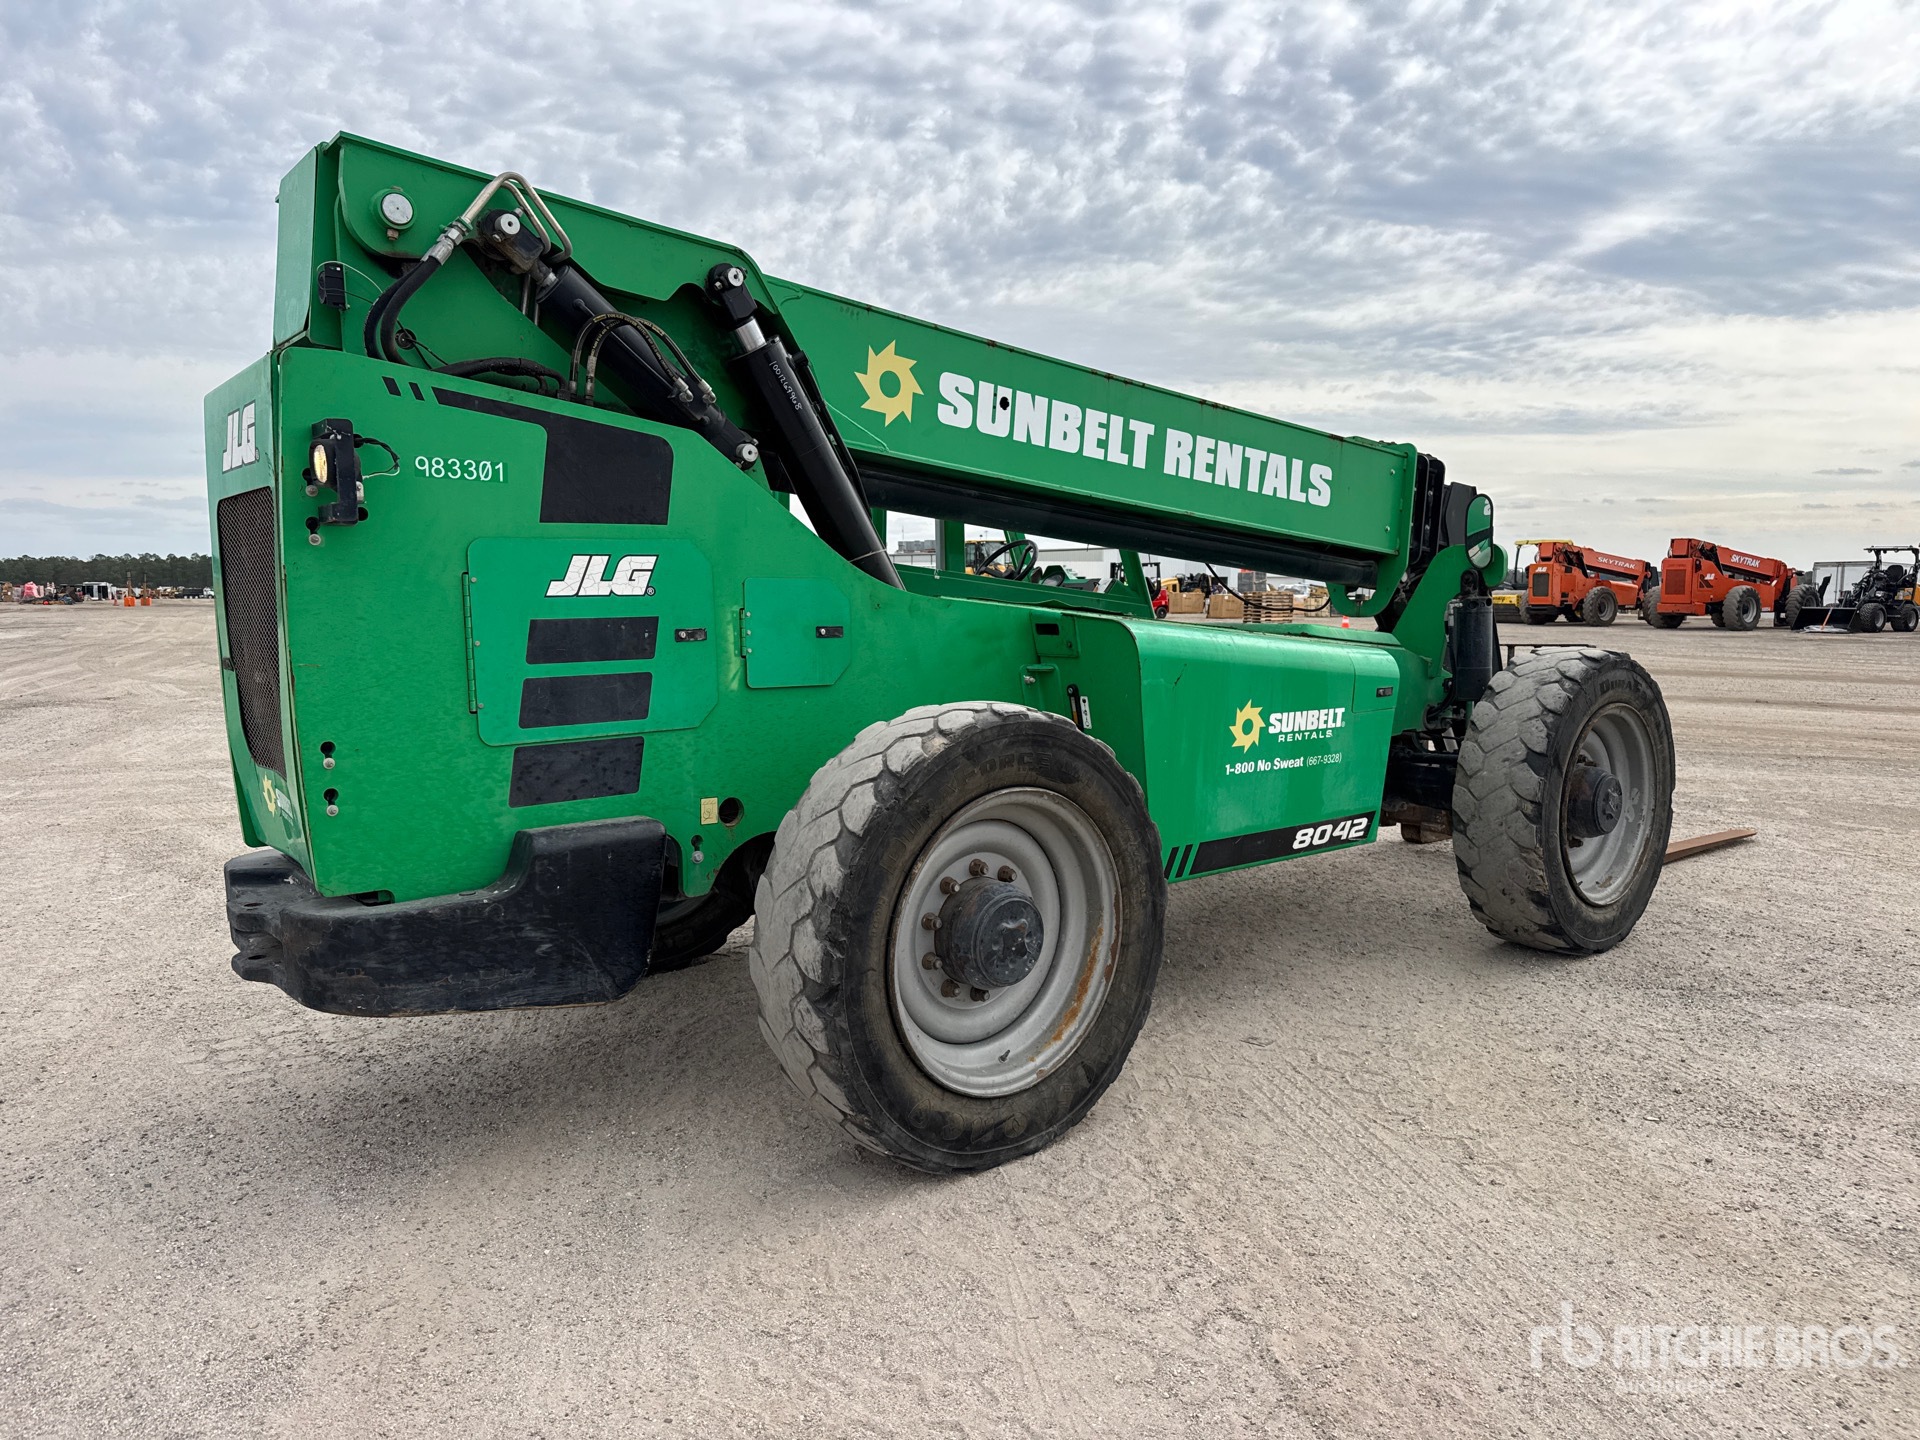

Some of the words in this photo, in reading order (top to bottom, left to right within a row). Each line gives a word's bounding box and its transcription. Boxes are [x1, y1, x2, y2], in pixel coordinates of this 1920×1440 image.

[222, 399, 257, 474] JLG
[938, 371, 1155, 470] SUNBELT
[1163, 427, 1332, 507] RENTALS
[415, 455, 504, 482] 983301
[1597, 556, 1636, 569] SKYTRAK
[1731, 554, 1760, 568] SKYTRAK
[545, 554, 659, 597] JLG
[1268, 708, 1345, 734] SUNBELT
[1278, 729, 1333, 742] RENTALS
[1225, 761, 1255, 775] 1-800
[1257, 759, 1271, 772] No
[1273, 756, 1304, 770] Sweat
[1306, 752, 1342, 767] (667-9328)
[1292, 817, 1368, 849] 8042
